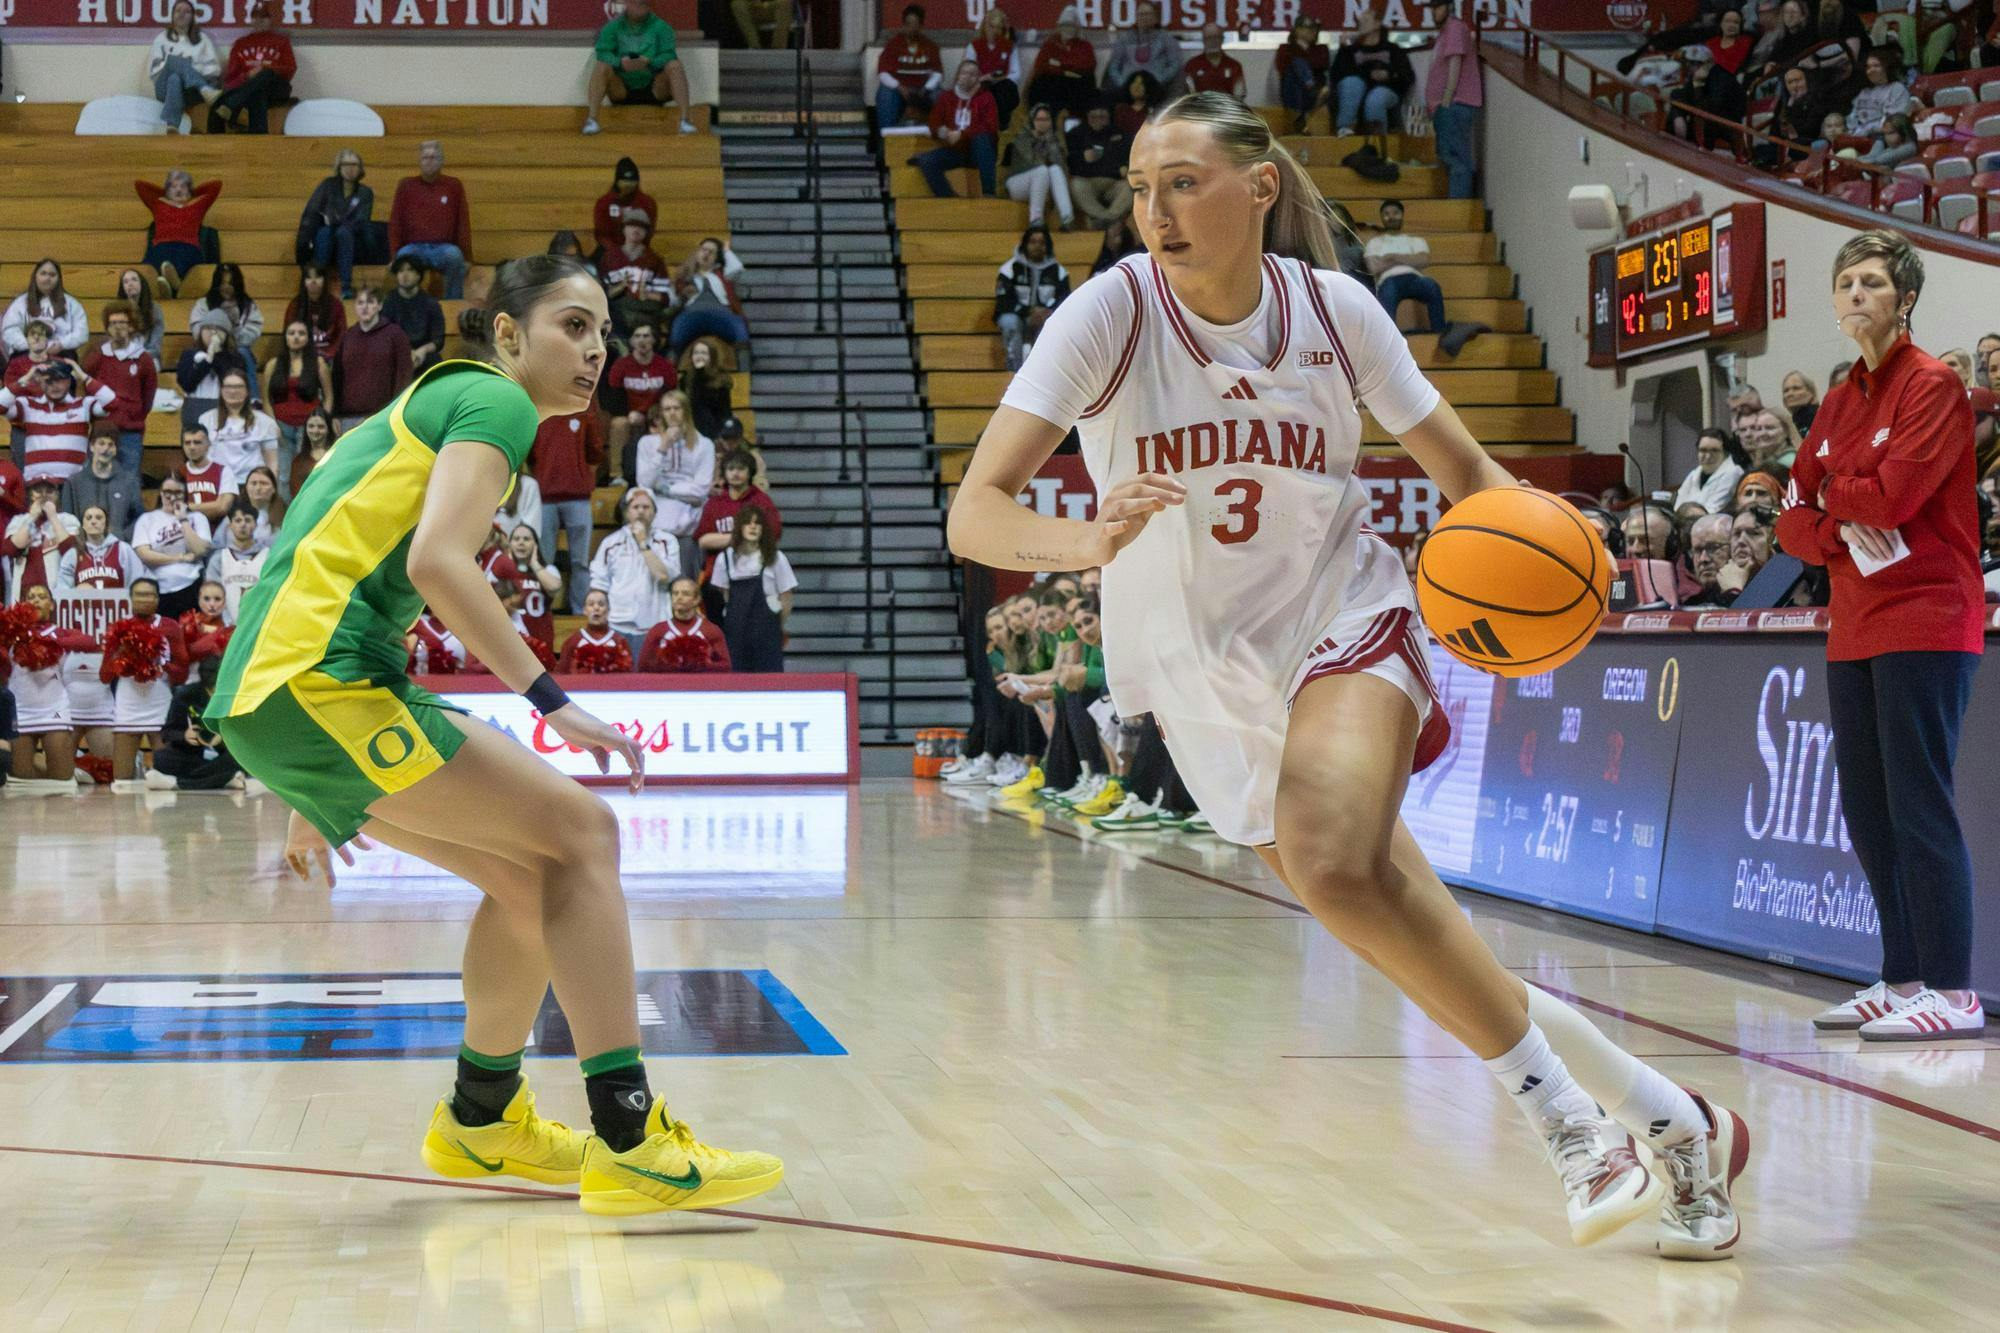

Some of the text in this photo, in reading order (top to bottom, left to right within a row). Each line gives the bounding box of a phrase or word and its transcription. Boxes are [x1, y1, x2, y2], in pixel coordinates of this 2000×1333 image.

[1135, 419, 1327, 476] INDIANA
[1211, 478, 1264, 545] 3
[1602, 667, 1648, 702] OREGON
[682, 721, 812, 754] LIGHT
[1535, 792, 1579, 864] 2:57
[1733, 858, 1818, 924] BioPharma
